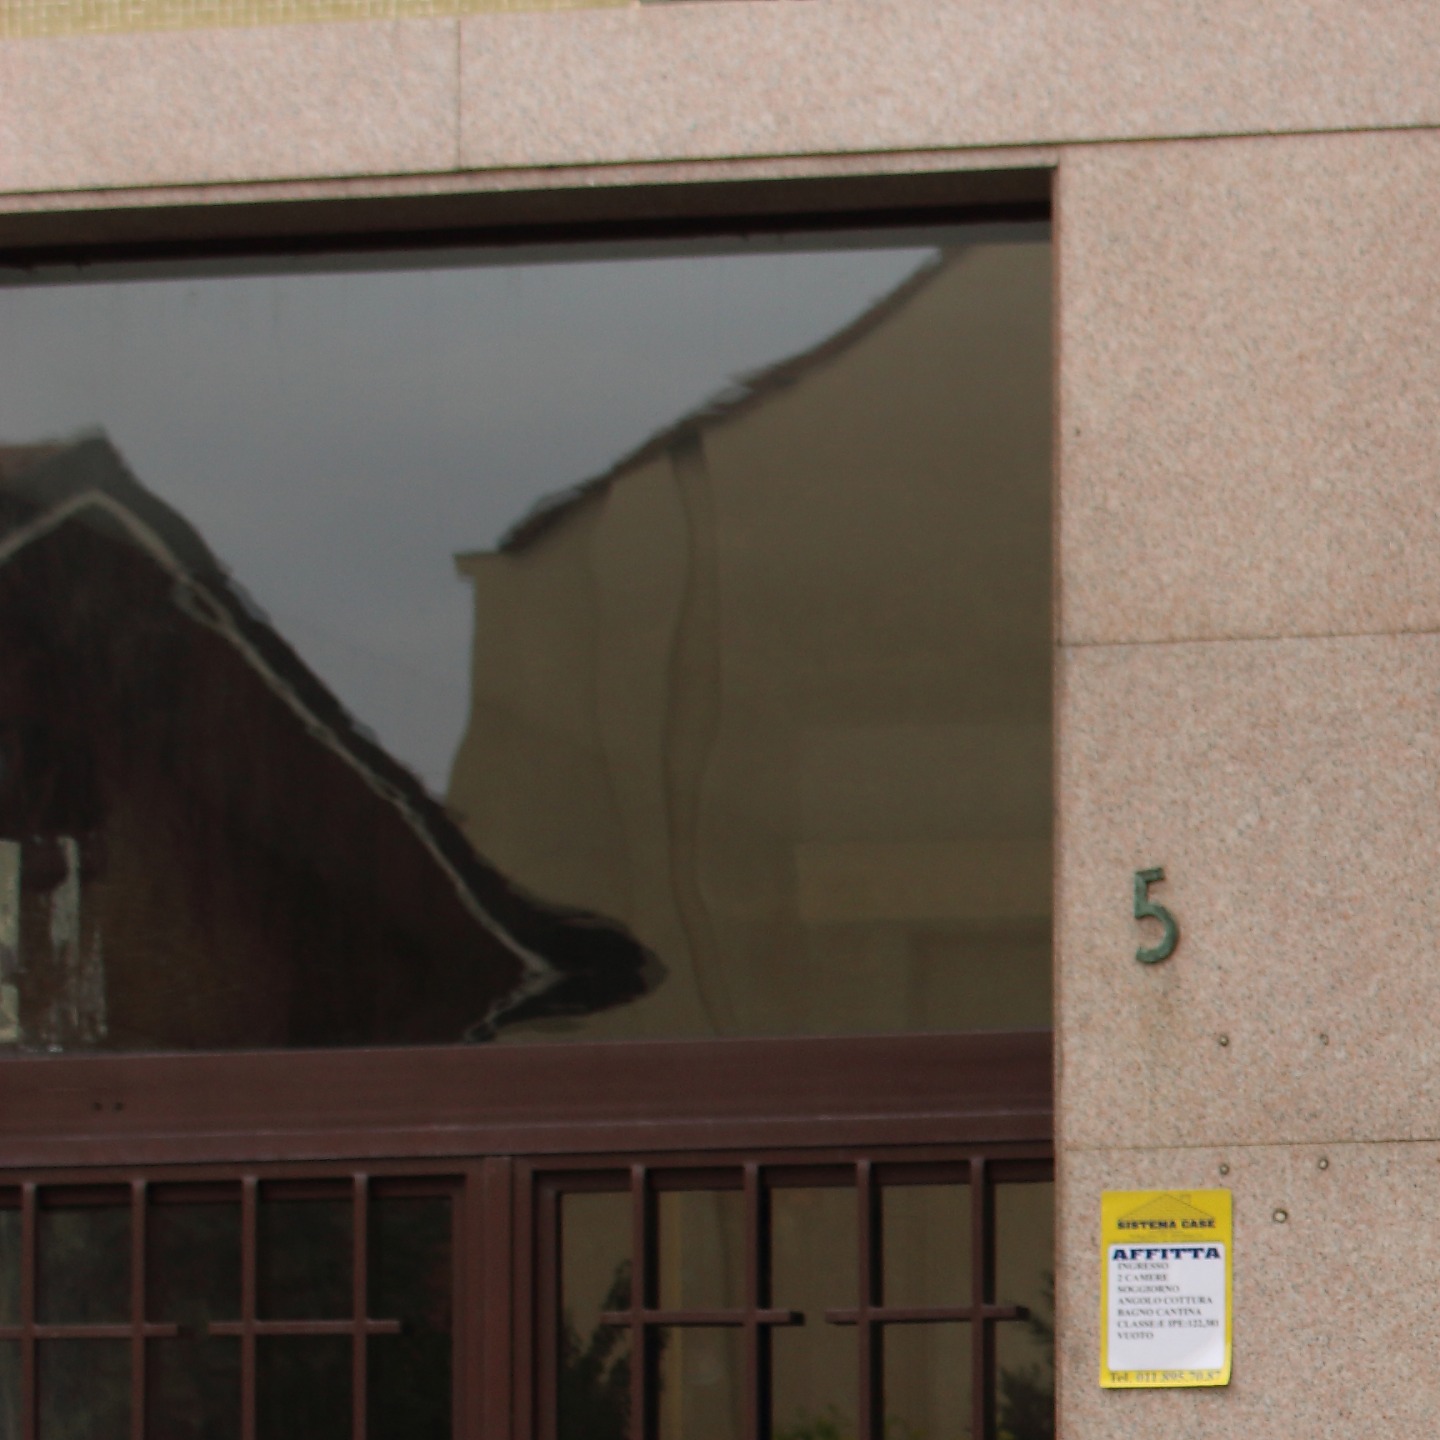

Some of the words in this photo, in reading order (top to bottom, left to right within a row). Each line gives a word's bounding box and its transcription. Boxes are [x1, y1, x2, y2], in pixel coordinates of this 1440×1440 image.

[1133, 866, 1180, 965] 5
[1117, 1218, 1177, 1230] SISTEMA
[1181, 1218, 1217, 1229] CASE
[1112, 1247, 1221, 1261] AFFITTA
